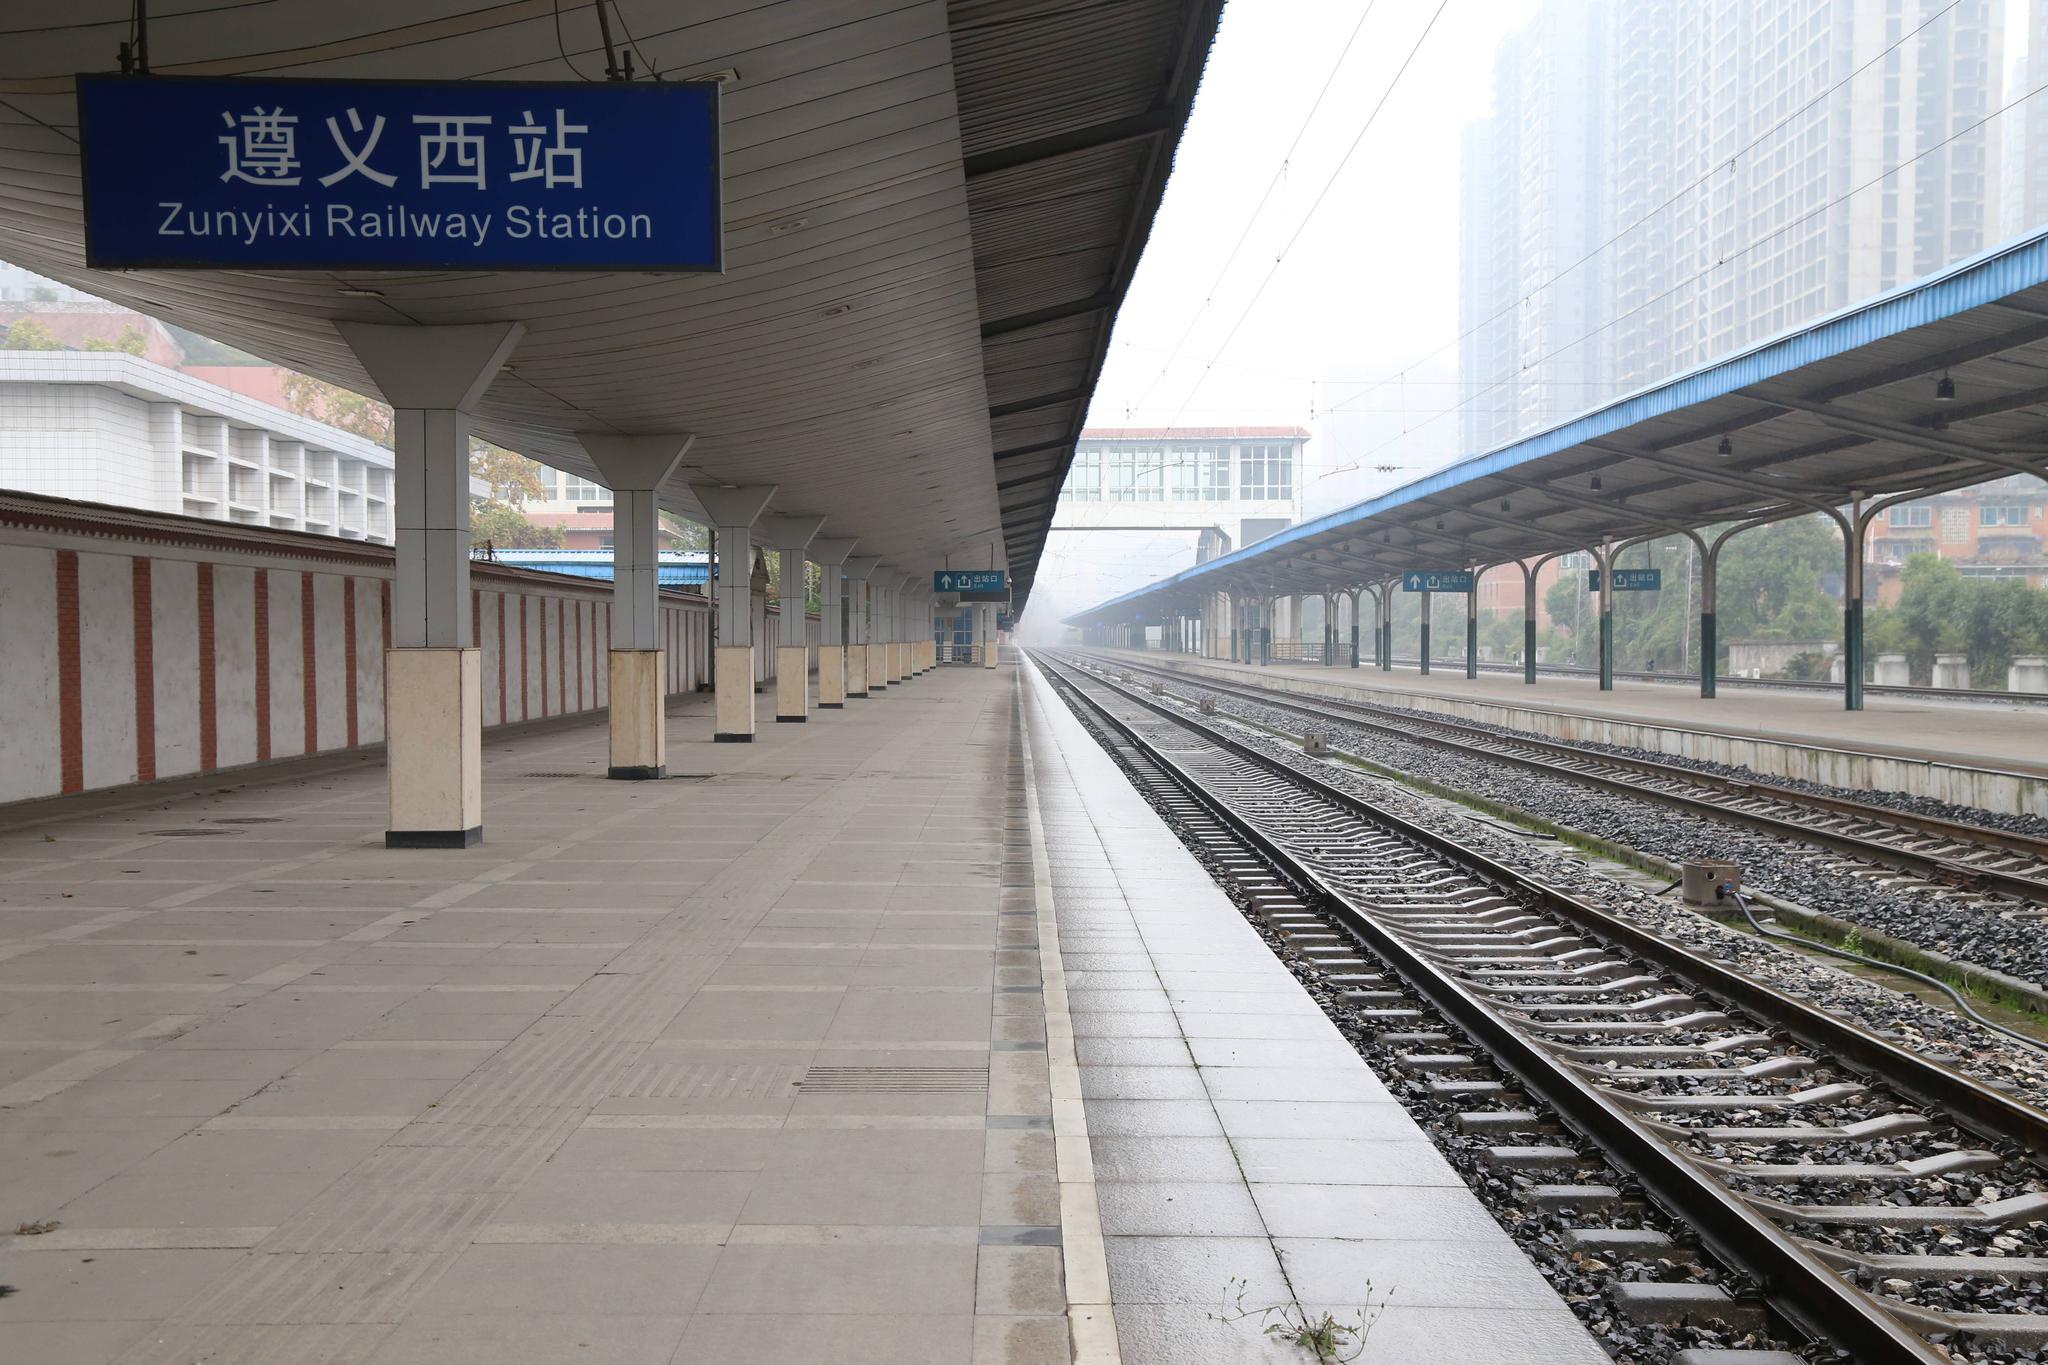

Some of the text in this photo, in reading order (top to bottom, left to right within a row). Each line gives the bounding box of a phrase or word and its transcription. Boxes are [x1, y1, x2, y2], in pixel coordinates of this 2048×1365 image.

[218, 105, 590, 191] 遵义西站
[158, 202, 652, 247] Zunyixi Railway Station
[973, 574, 998, 583] 出站口
